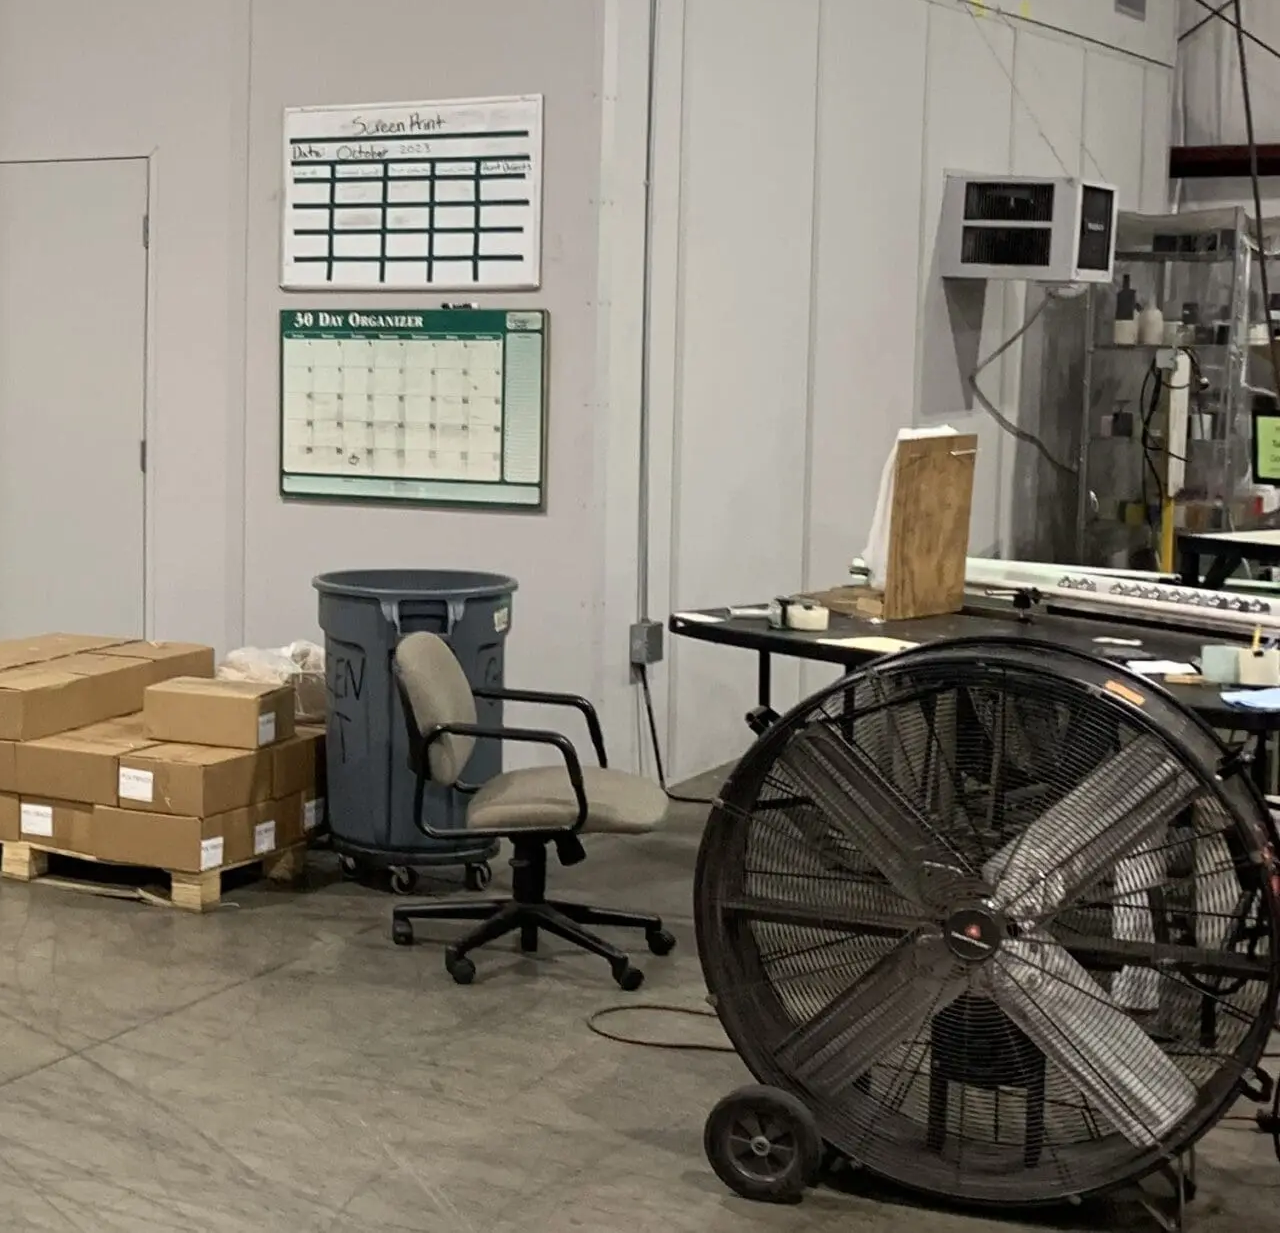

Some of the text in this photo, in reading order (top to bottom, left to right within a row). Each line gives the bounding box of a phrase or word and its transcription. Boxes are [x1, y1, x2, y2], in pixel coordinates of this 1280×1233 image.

[352, 111, 446, 136] Screen Print
[336, 144, 389, 160] October
[293, 312, 313, 327] 30
[348, 312, 424, 328] ORGANIZER
